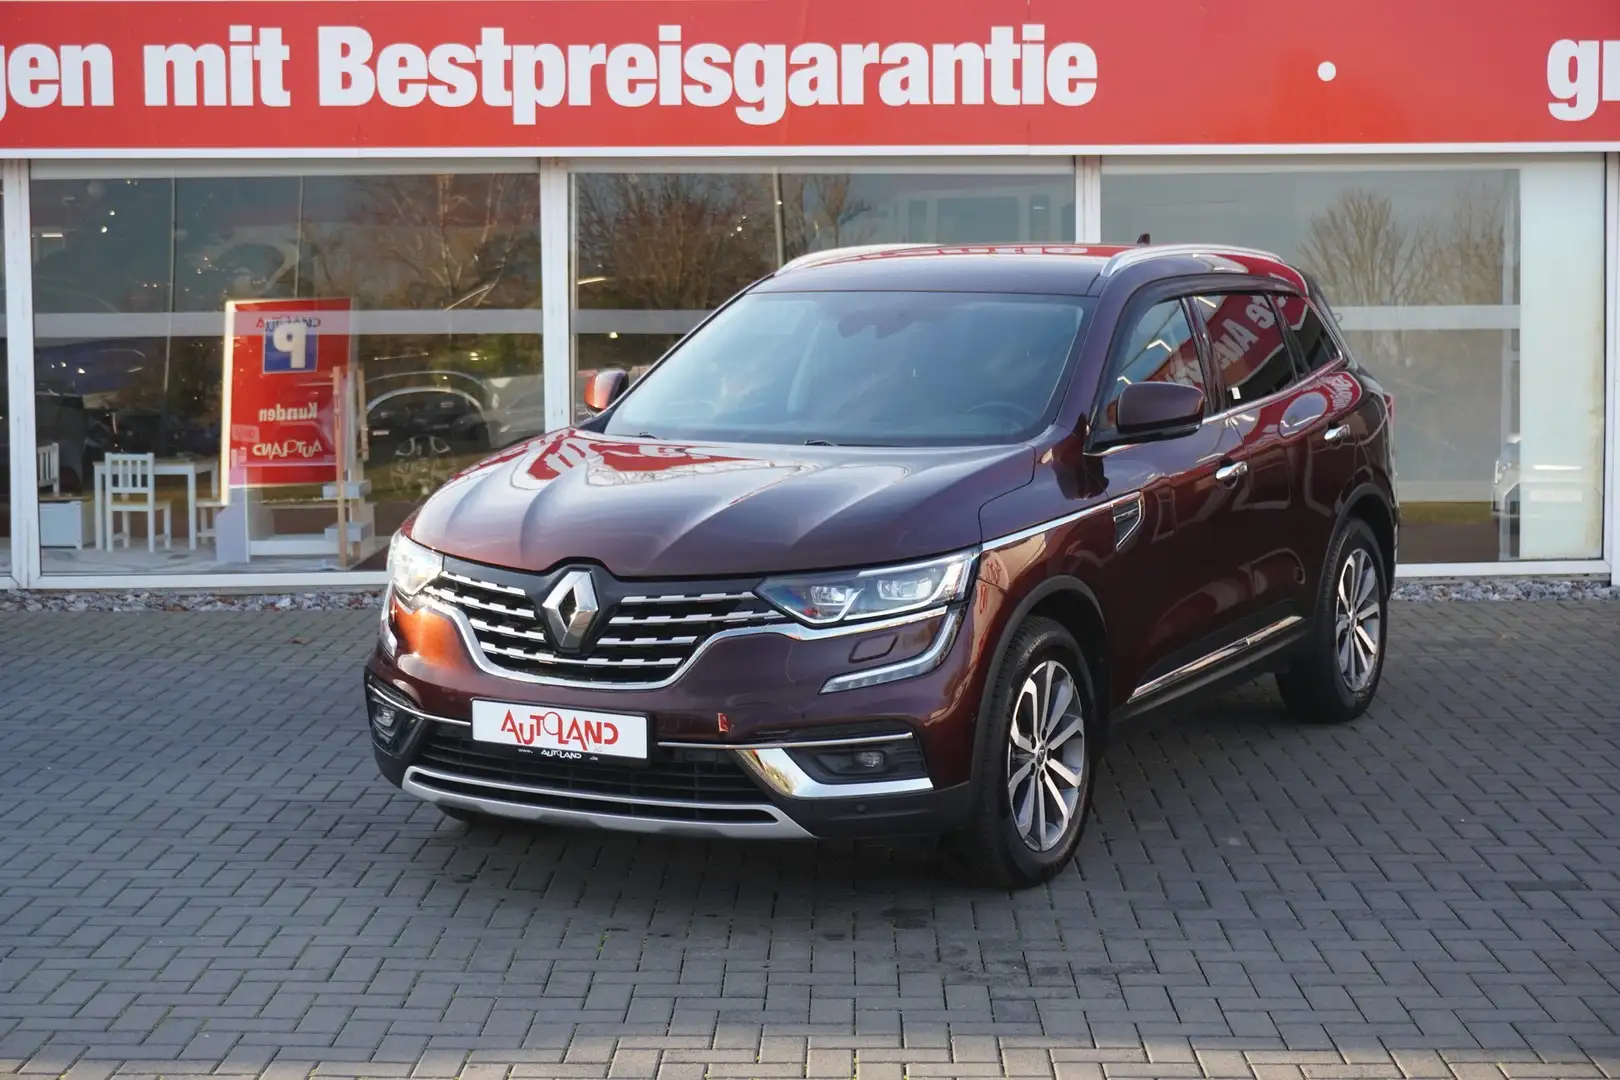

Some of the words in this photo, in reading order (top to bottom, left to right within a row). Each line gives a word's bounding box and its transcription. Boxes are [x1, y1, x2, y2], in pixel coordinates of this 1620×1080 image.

[0, 44, 114, 122] en
[143, 25, 291, 107] mit
[318, 24, 1098, 126] Bestpreisgarantie
